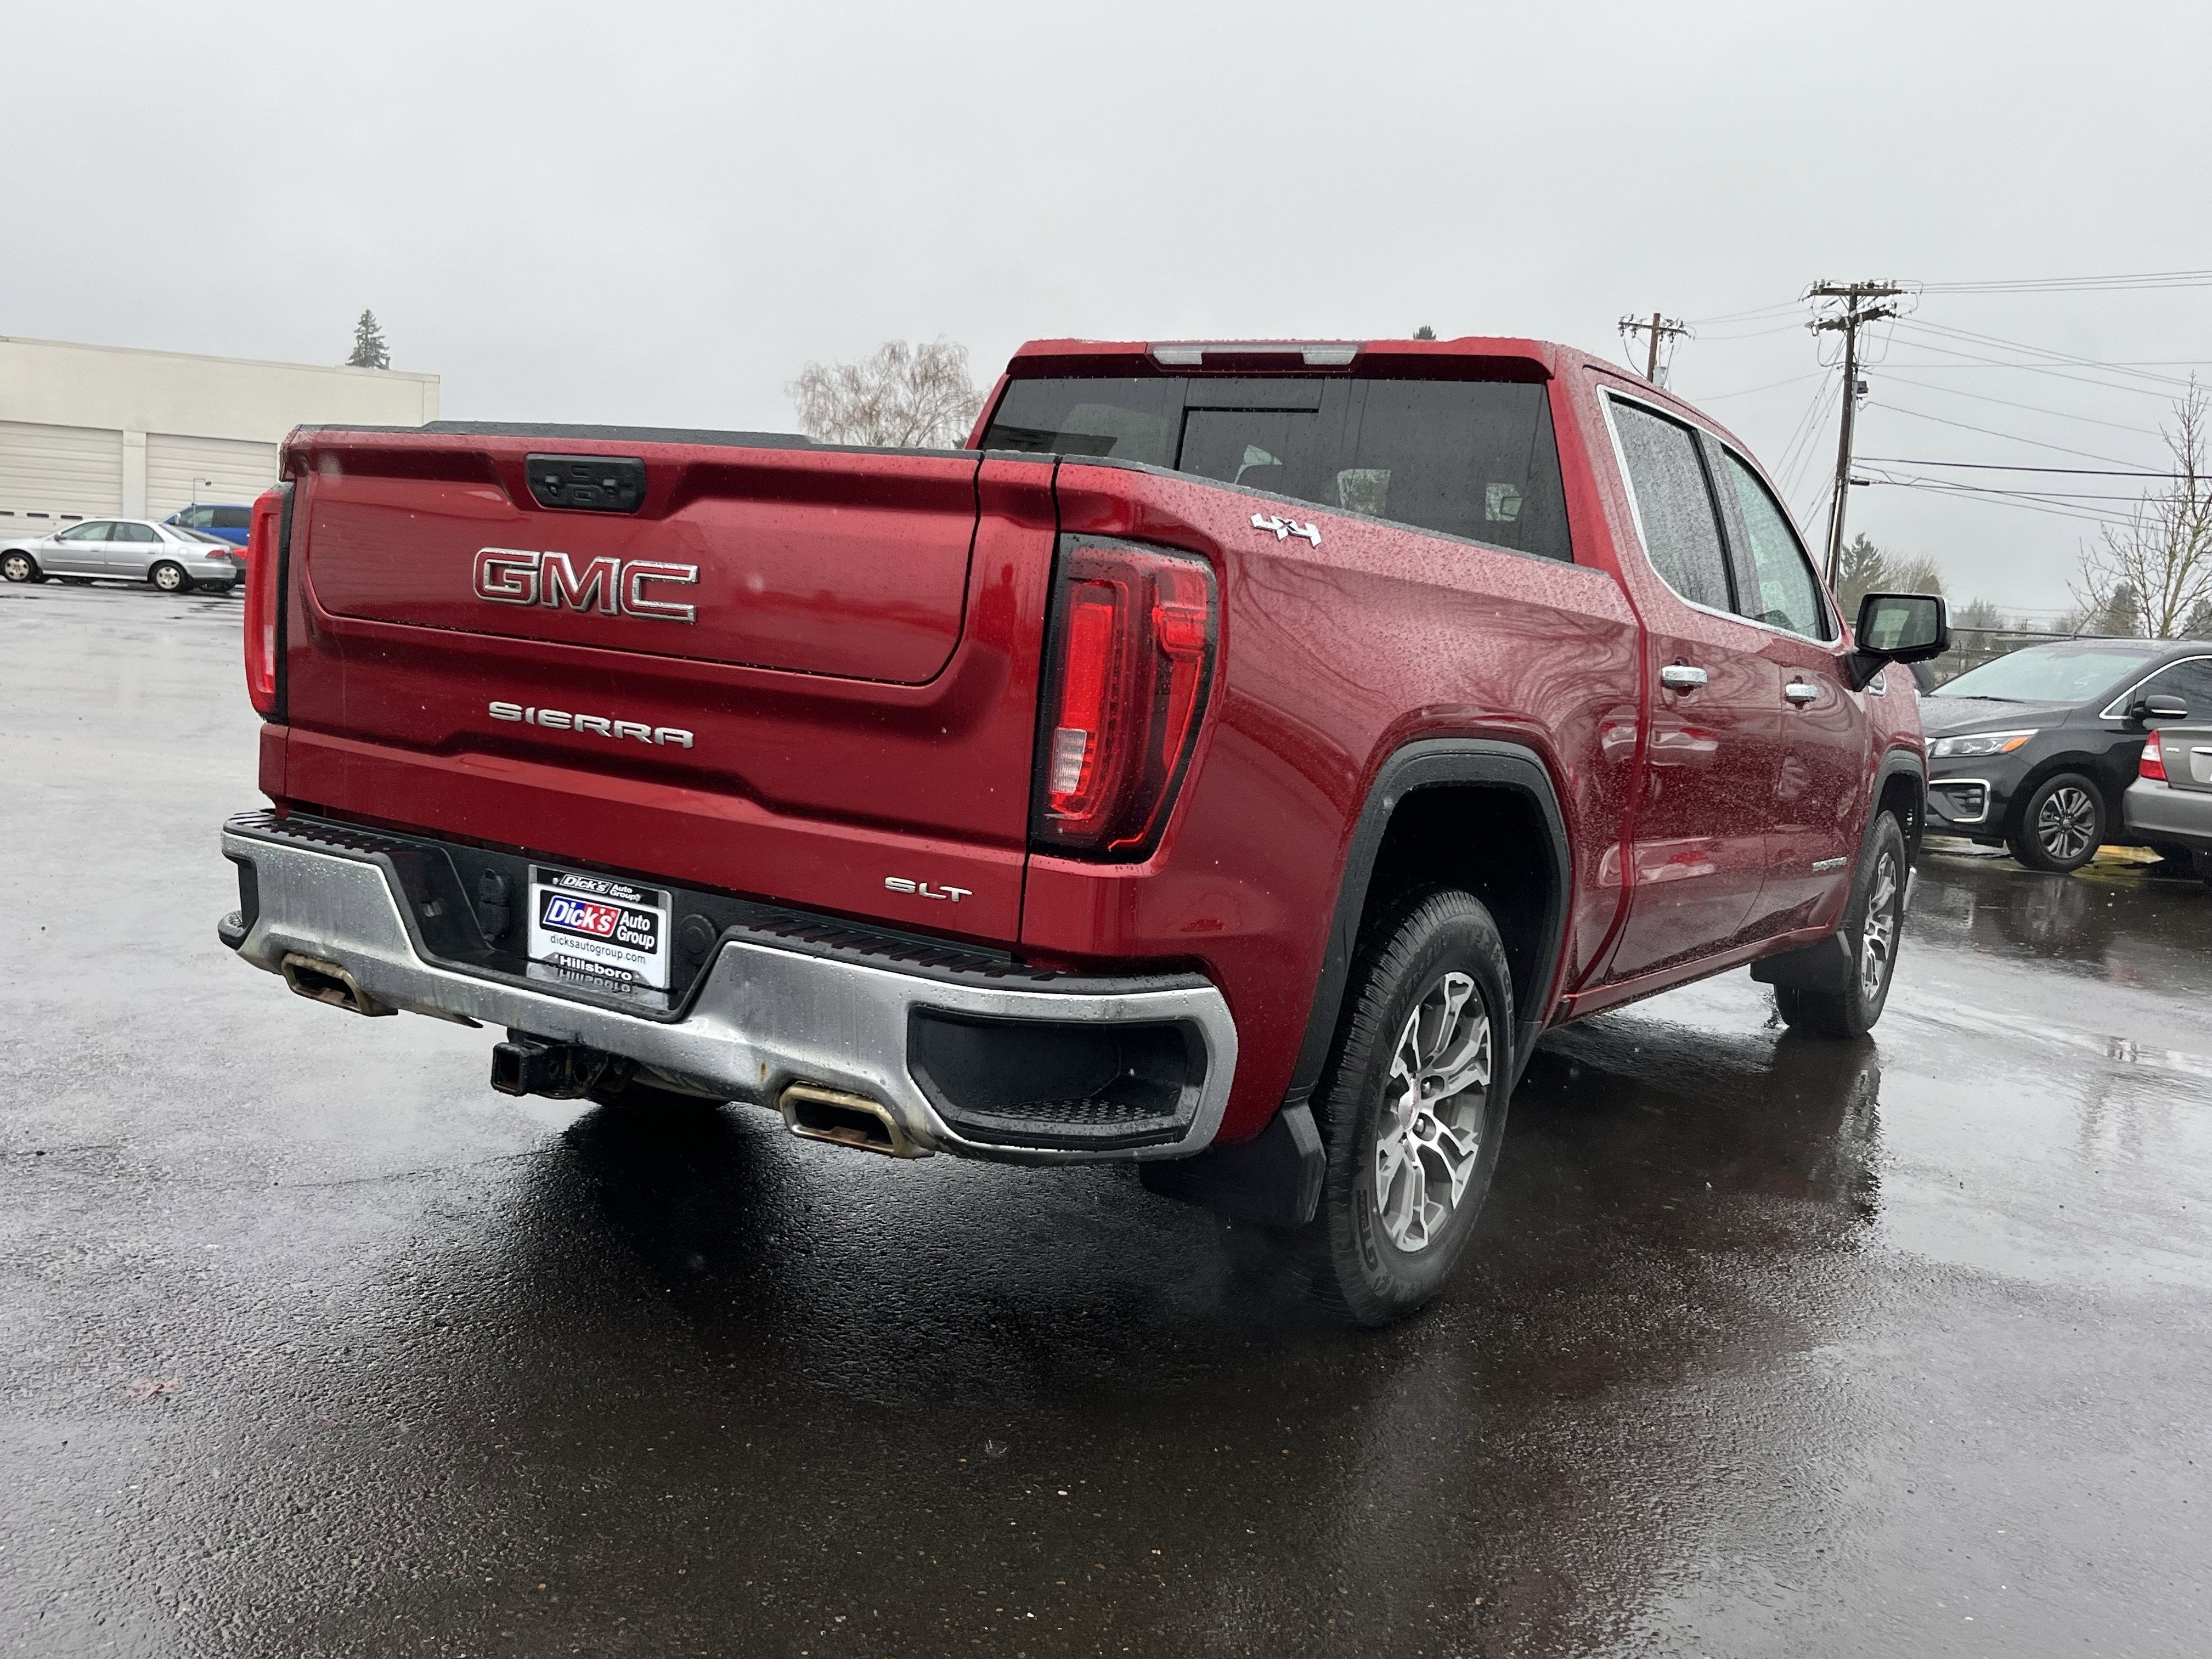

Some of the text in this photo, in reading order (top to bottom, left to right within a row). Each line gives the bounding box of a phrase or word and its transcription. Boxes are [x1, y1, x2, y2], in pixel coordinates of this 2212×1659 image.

[473, 548, 699, 623] GMC
[489, 702, 695, 749] SIERRA
[563, 876, 633, 894] Dick's Auto
[610, 889, 635, 901] Group
[885, 877, 973, 902] SLT
[548, 900, 651, 933] Dick's Auto
[550, 934, 646, 964] dicksautogroup.com
[617, 925, 655, 950] Group
[560, 955, 632, 981] Hillsboro
